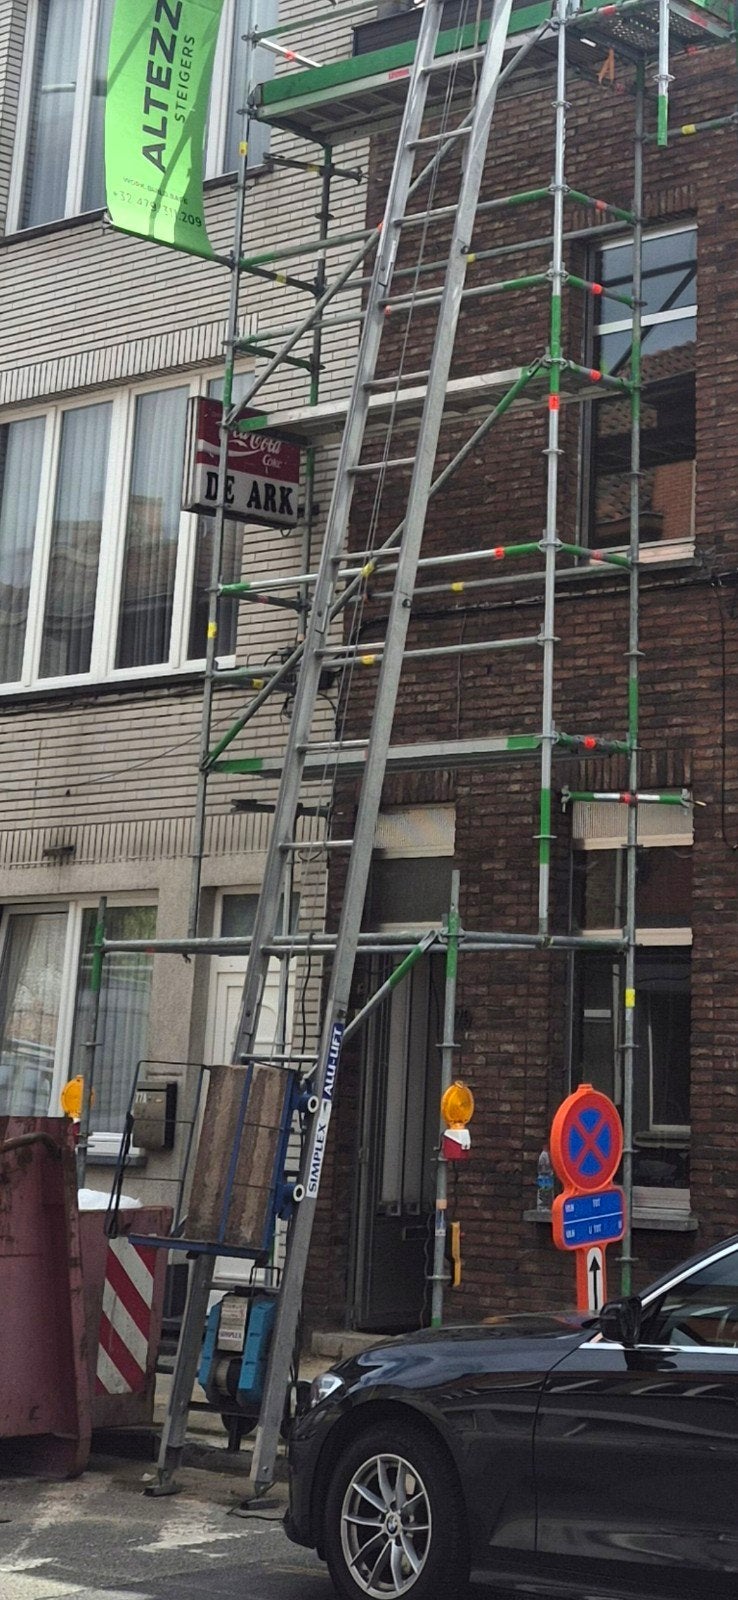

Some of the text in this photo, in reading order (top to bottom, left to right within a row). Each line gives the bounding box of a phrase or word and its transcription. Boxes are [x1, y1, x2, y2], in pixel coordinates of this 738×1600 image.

[174, 35, 195, 123] STEIGERS
[205, 471, 293, 515] DE ARK
[323, 1026, 343, 1096] ALU-LIFT
[308, 1123, 327, 1193] SIMPLEX
